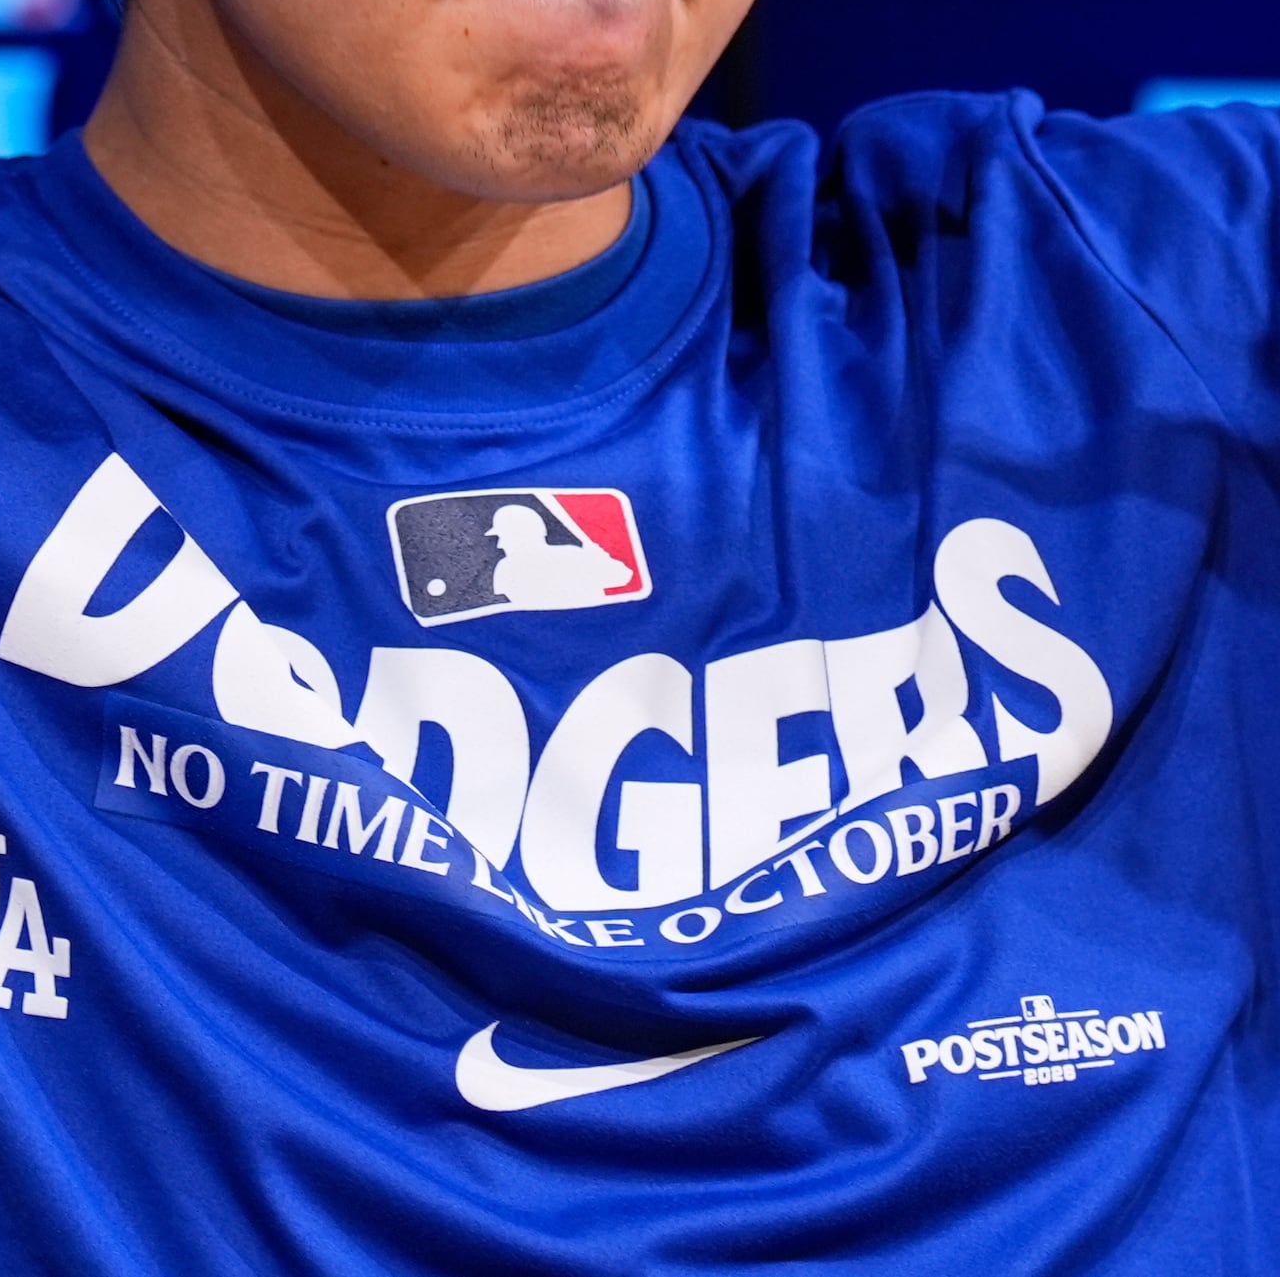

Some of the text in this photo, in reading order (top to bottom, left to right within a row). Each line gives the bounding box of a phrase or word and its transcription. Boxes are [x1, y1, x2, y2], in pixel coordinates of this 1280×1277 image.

[113, 724, 226, 810] NO
[250, 760, 456, 877] TIME
[658, 782, 1022, 945] OCTOBER
[900, 1010, 1166, 1084] POSTSEASON
[1023, 1063, 1077, 1086] 2026
